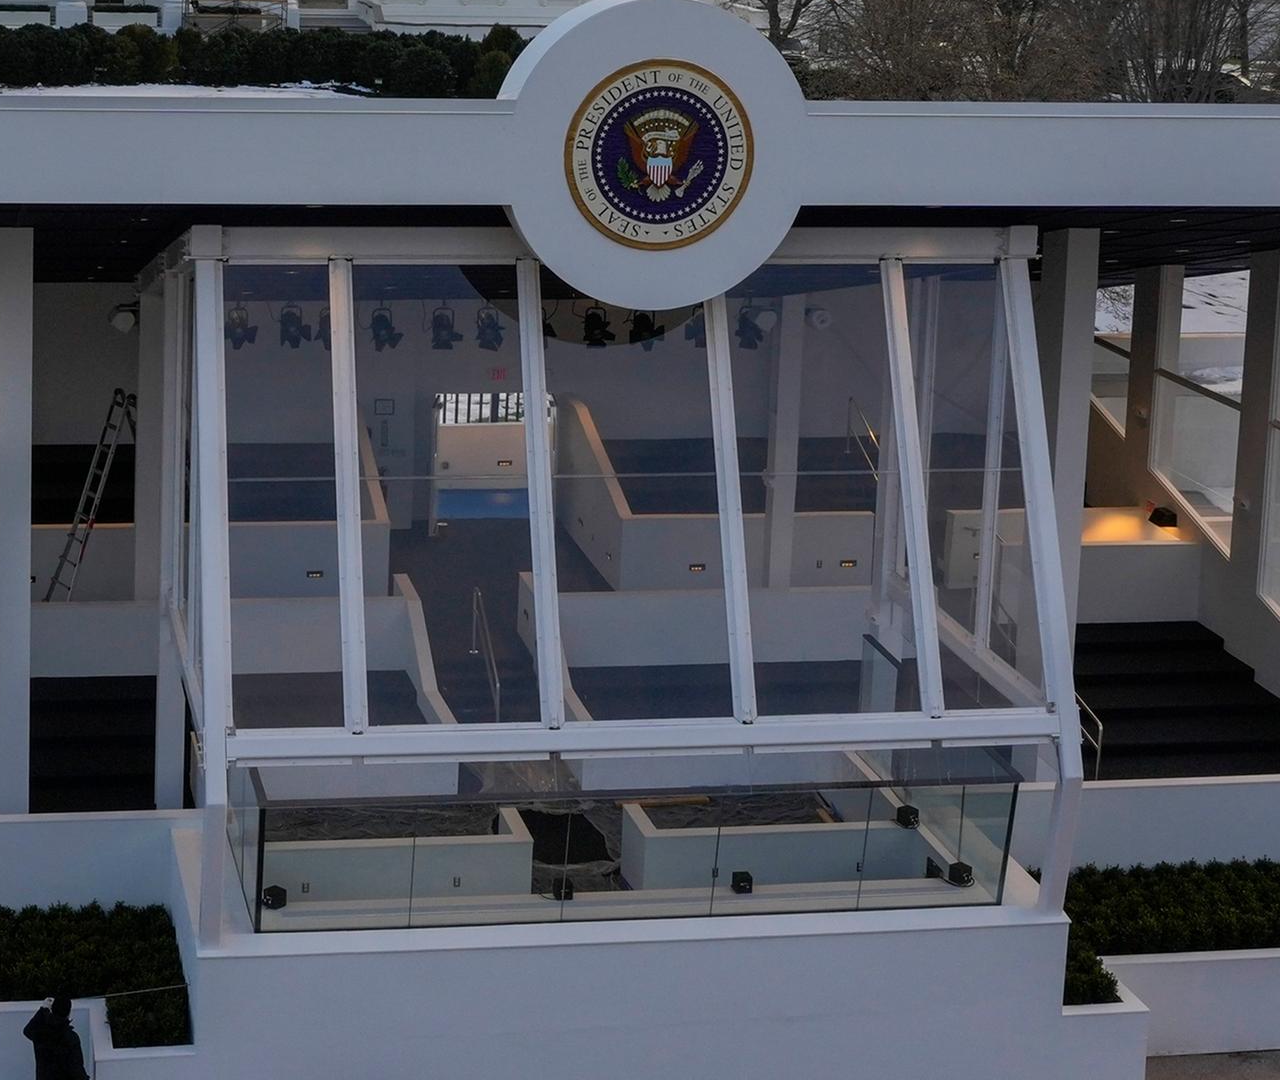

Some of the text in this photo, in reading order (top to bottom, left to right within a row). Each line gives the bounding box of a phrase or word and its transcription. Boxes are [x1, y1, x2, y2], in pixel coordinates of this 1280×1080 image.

[576, 70, 744, 238] SEAL OF THE PRESIDENT OF THE UNITED STATES
